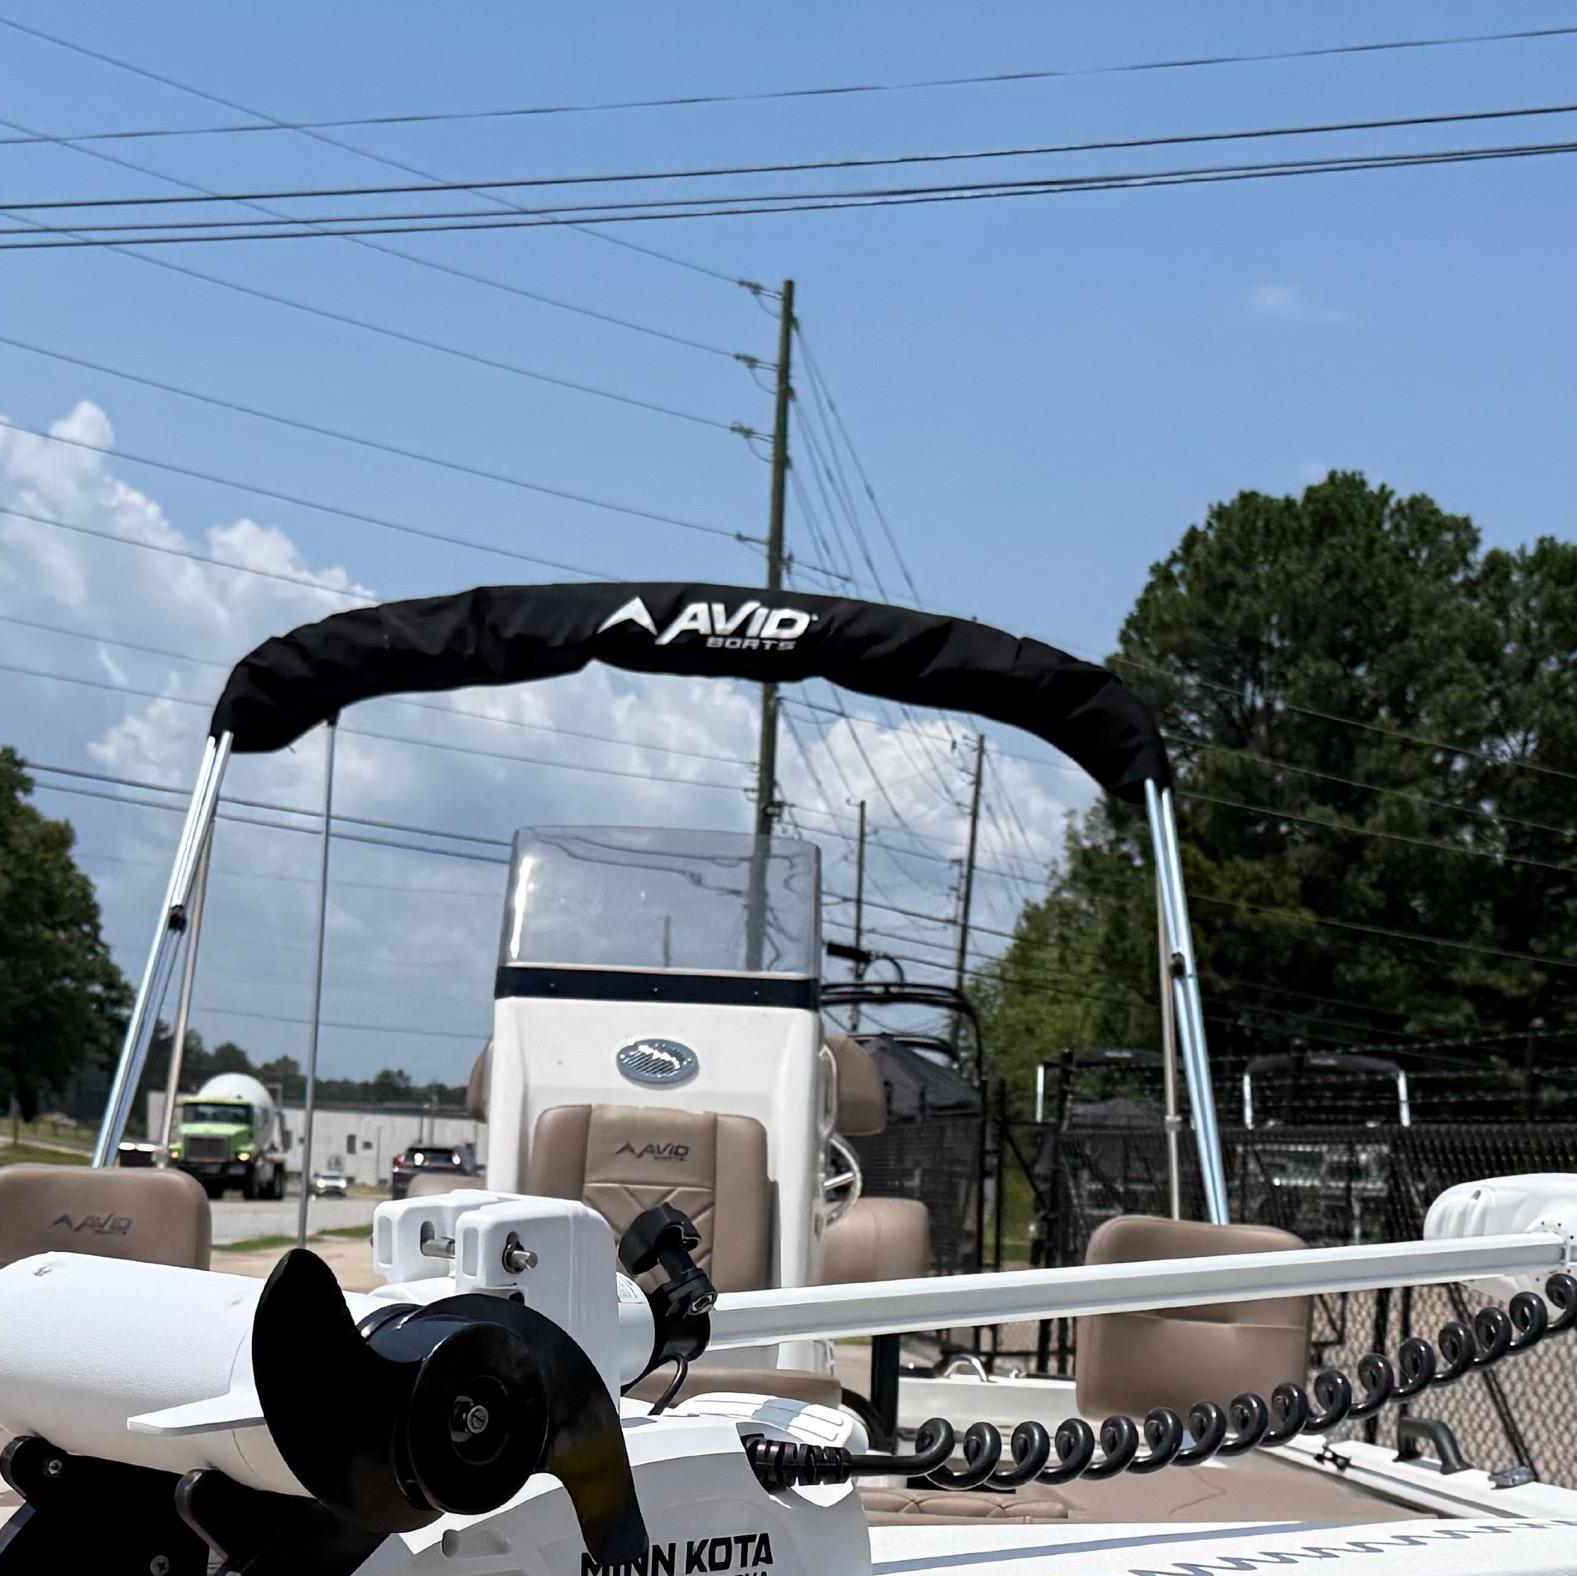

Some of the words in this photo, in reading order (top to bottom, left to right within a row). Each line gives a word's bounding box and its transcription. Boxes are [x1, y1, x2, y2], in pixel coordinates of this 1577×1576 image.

[654, 601, 812, 646] AVID
[705, 636, 797, 651] BOATS
[635, 1142, 690, 1159] AVID
[685, 1532, 774, 1575] KOTA
